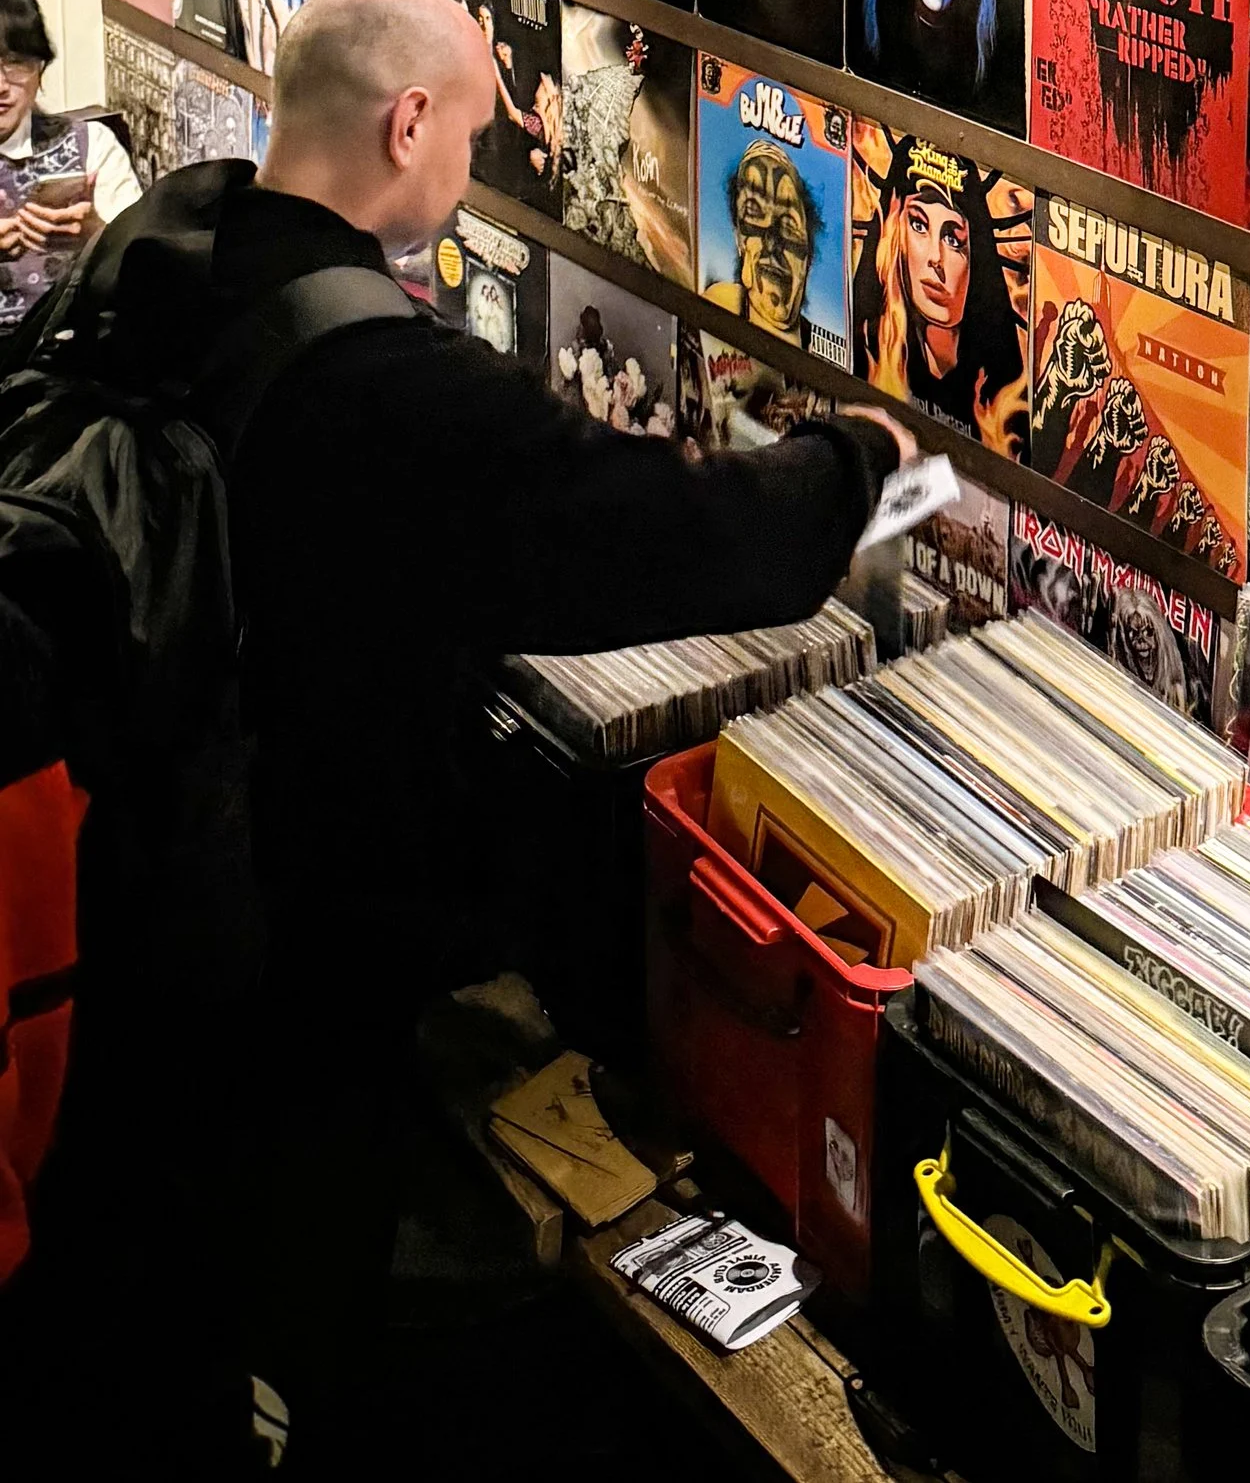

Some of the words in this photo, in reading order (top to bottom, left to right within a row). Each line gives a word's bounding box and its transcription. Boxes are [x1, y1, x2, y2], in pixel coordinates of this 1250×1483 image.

[739, 92, 805, 148] BUNGLE
[906, 156, 968, 193] Diamond
[1048, 194, 1236, 324] SEPULTURA
[1144, 339, 1221, 388] NATION
[1013, 499, 1087, 583] IRON
[916, 541, 938, 577] OF
[938, 554, 951, 584] A
[955, 561, 1006, 620] DOWN
[722, 1261, 783, 1295] AMSTERDAM
[725, 1253, 767, 1265] VINYL
